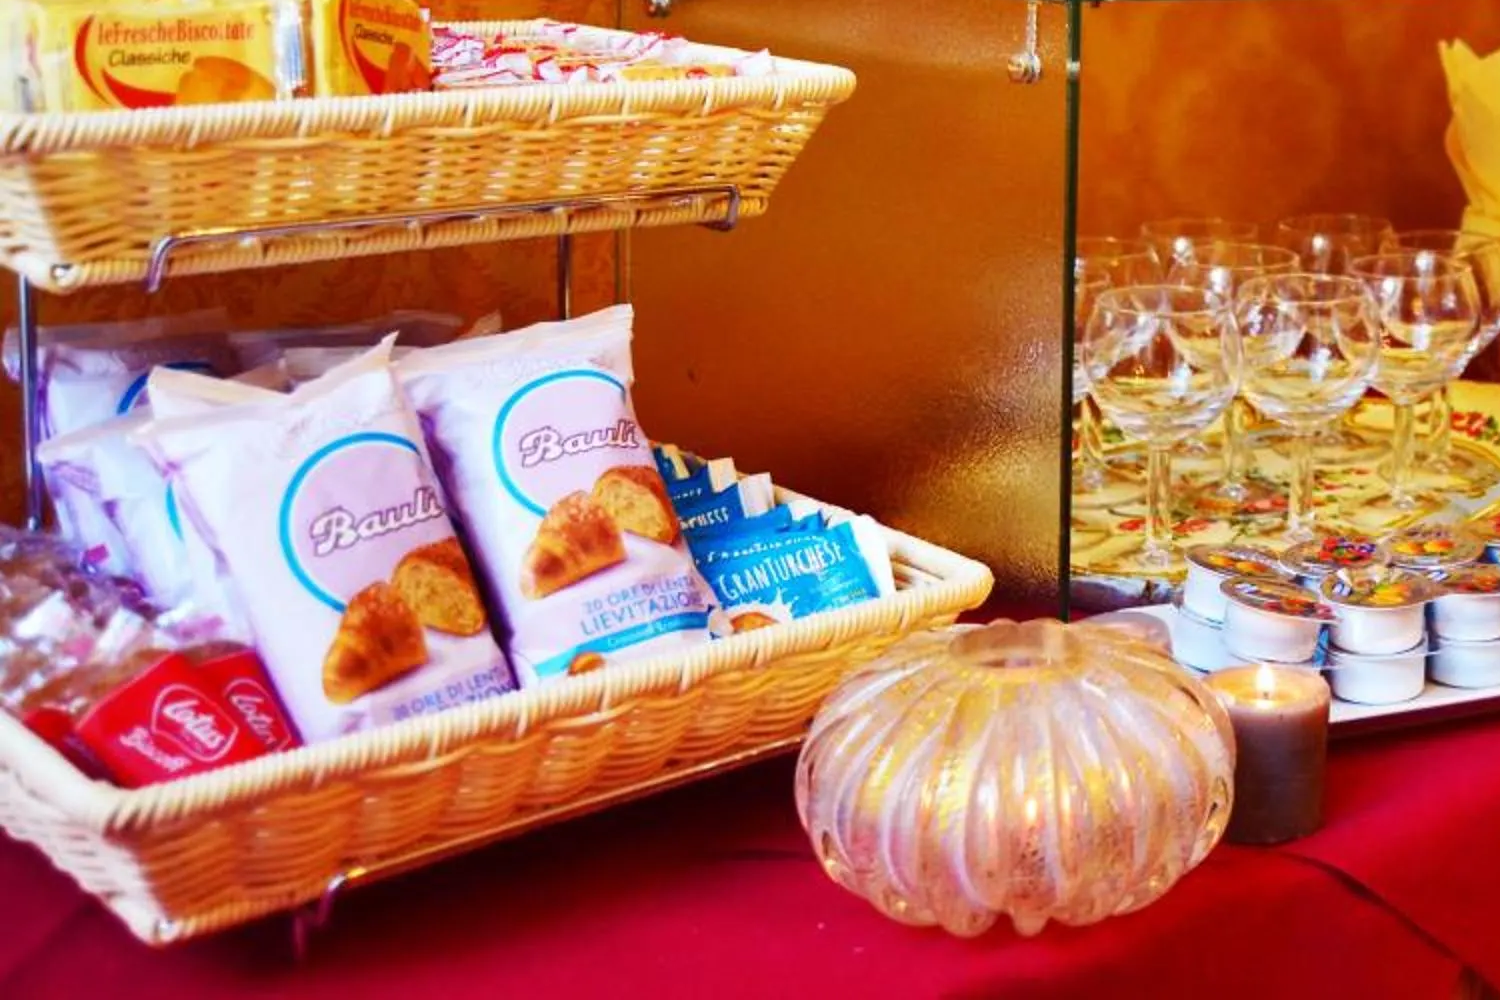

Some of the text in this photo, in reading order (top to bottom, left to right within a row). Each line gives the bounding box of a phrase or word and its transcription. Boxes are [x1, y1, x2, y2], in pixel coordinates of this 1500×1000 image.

[108, 49, 191, 68] Classiche
[518, 418, 640, 469] Bauli
[309, 486, 444, 557] Bauli
[162, 699, 225, 749] Lotus
